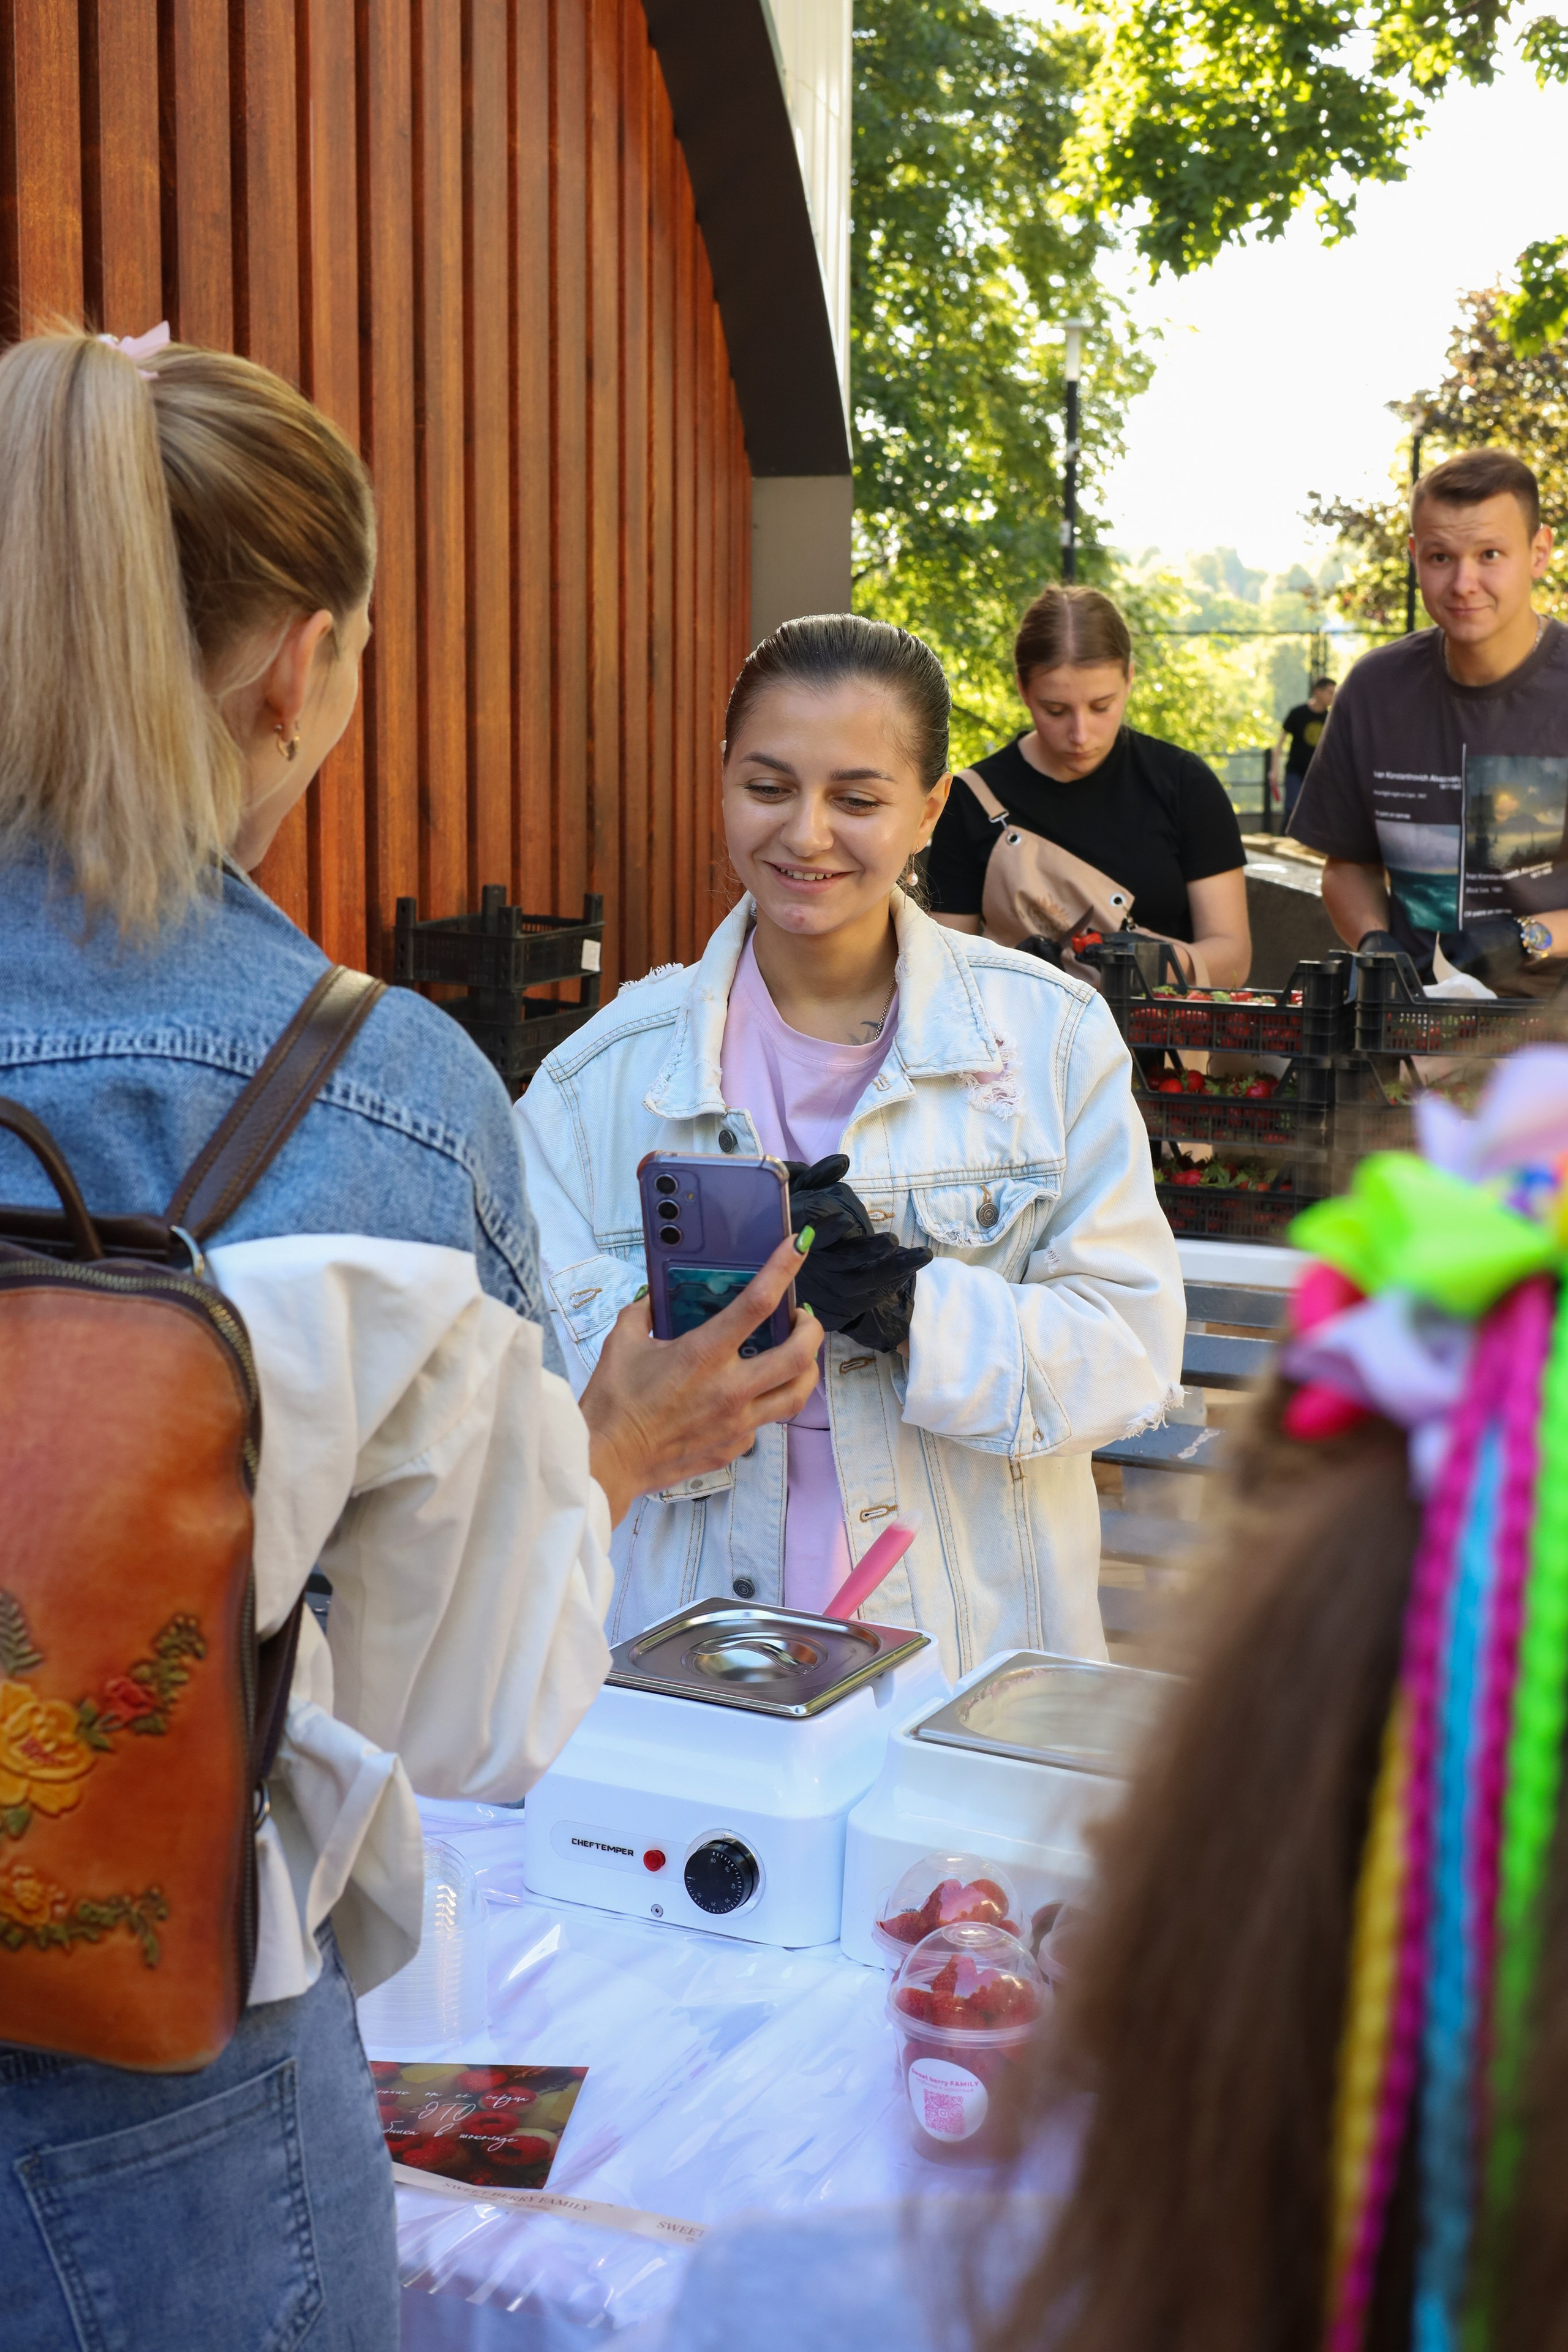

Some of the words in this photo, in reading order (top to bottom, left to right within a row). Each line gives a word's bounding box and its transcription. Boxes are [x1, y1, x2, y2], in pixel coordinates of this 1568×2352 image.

[571, 1838, 634, 1856] CHEFTEMPER
[929, 2076, 949, 2086] berry
[486, 2094, 530, 2109] сердца
[459, 2133, 519, 2152] шоколаде
[443, 2182, 492, 2196] SWEET
[491, 2191, 539, 2203] BERRY
[538, 2196, 593, 2212] FAMILY
[657, 2221, 705, 2237] SWEET
